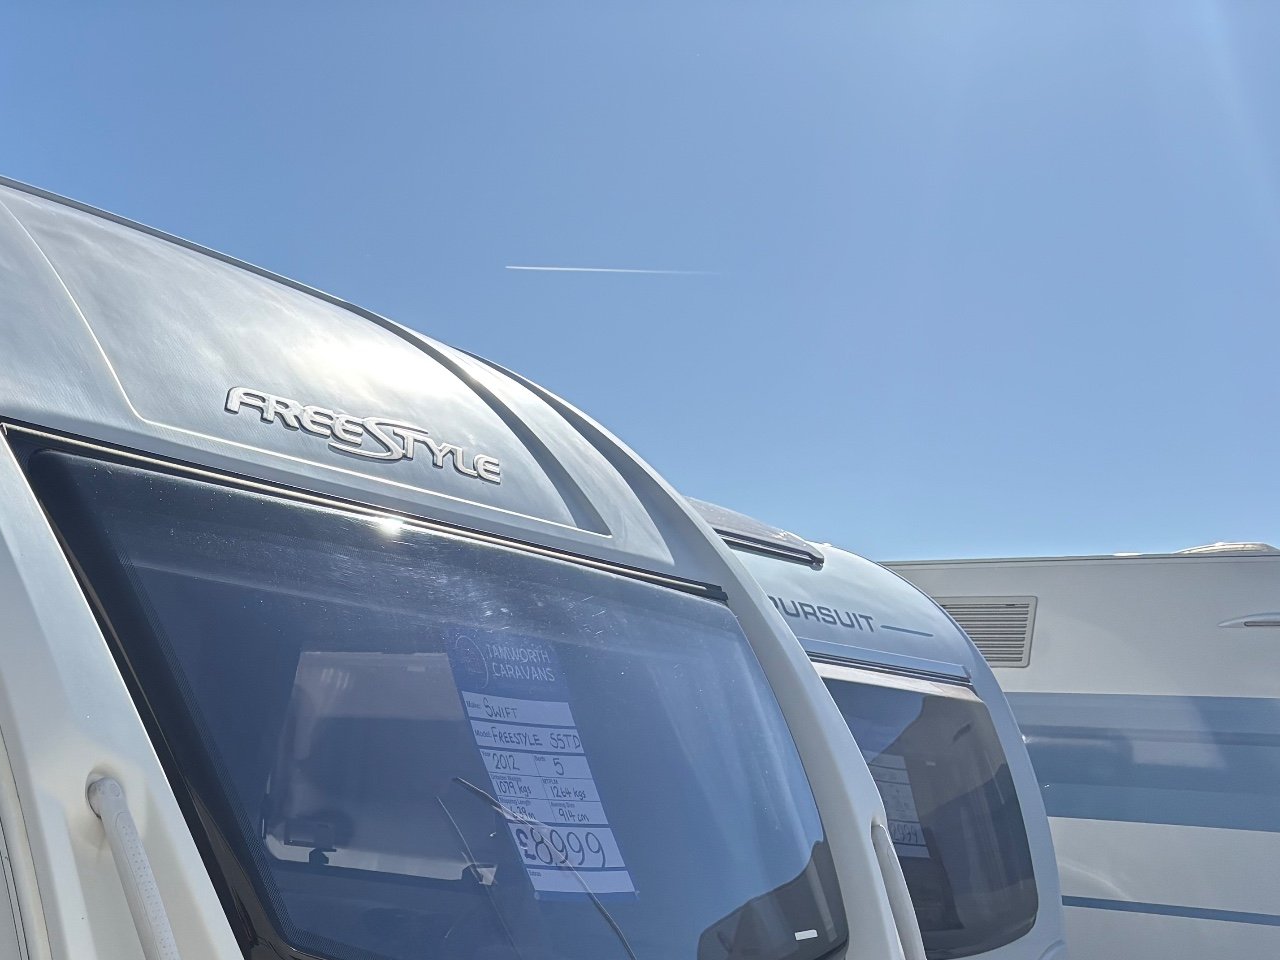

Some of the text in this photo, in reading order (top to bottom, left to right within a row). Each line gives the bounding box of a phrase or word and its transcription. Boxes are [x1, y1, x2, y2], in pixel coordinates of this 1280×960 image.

[486, 644, 551, 663] TAMWORTH
[492, 662, 556, 682] CARAVANS
[490, 726, 543, 747] FREESTYLE
[492, 753, 520, 771] 2012
[552, 757, 565, 776] 5
[495, 780, 532, 797] 1079 kgs
[574, 786, 587, 801] kgs
[558, 808, 590, 823] 914 cm
